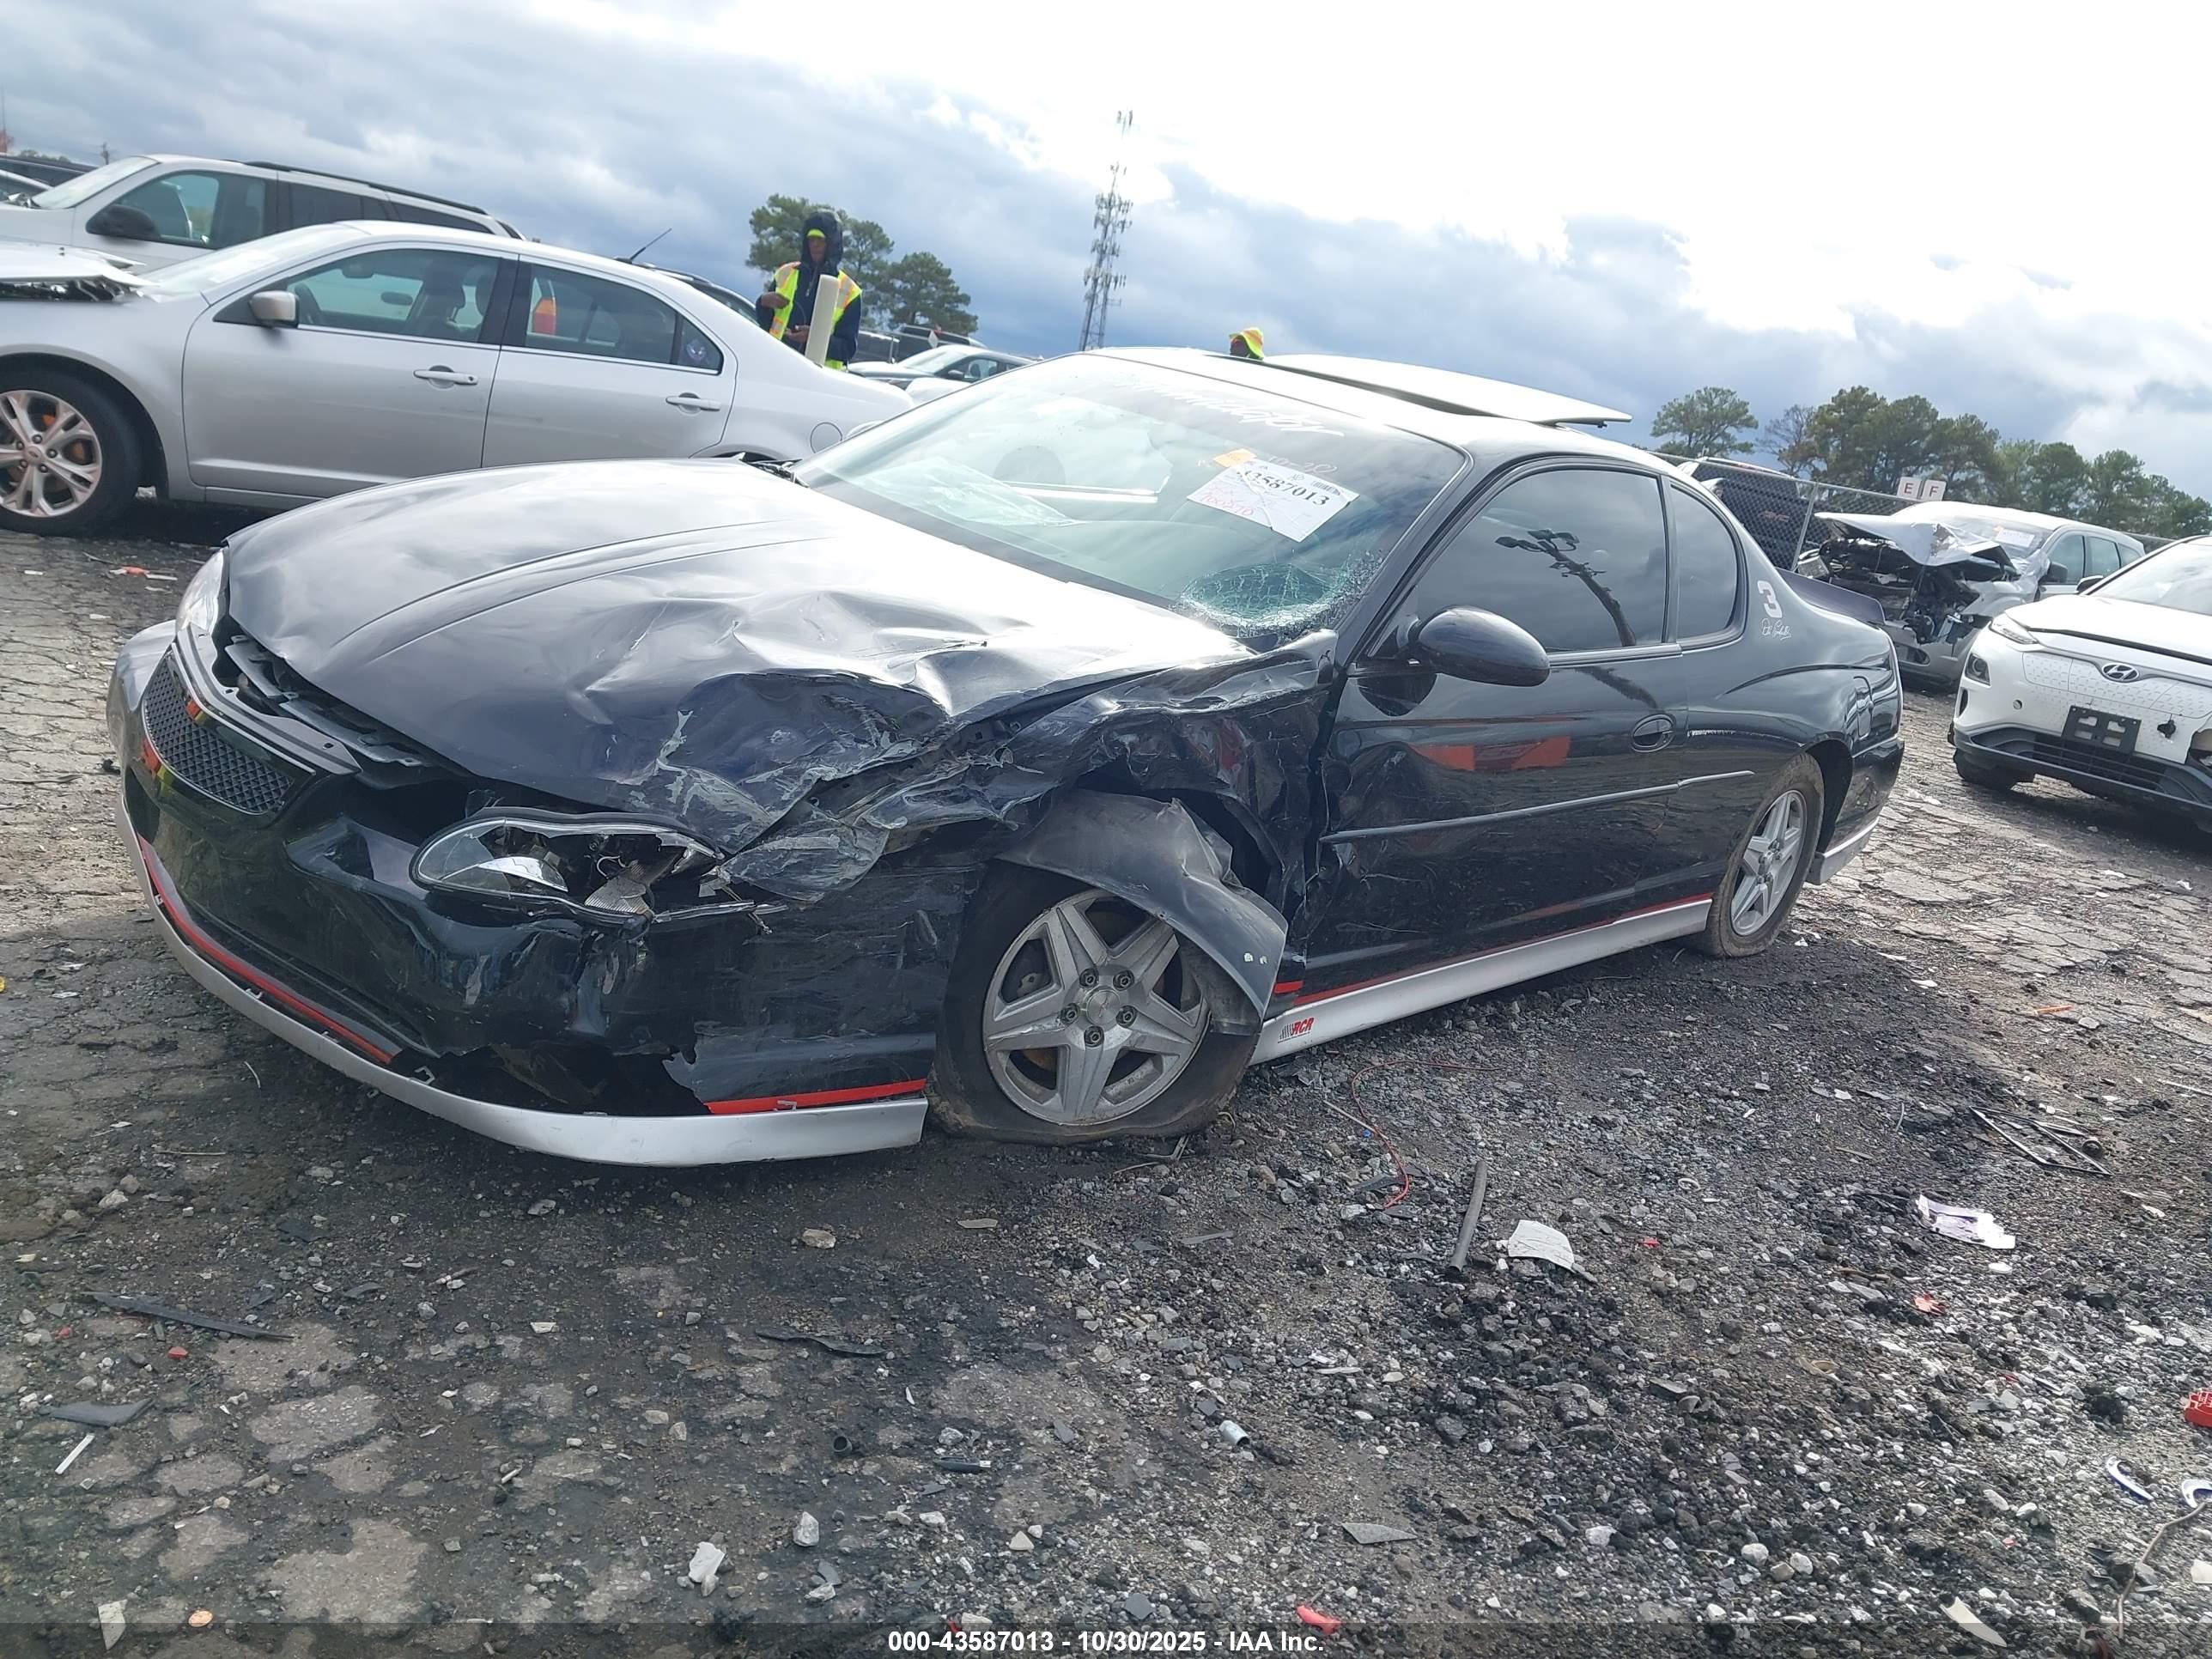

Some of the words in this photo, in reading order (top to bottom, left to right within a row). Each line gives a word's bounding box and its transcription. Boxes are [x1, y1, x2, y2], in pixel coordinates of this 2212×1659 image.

[1904, 483, 1914, 494] E
[1929, 485, 1939, 497] F
[1757, 580, 1783, 618] 3
[1291, 1017, 1315, 1036] RCR
